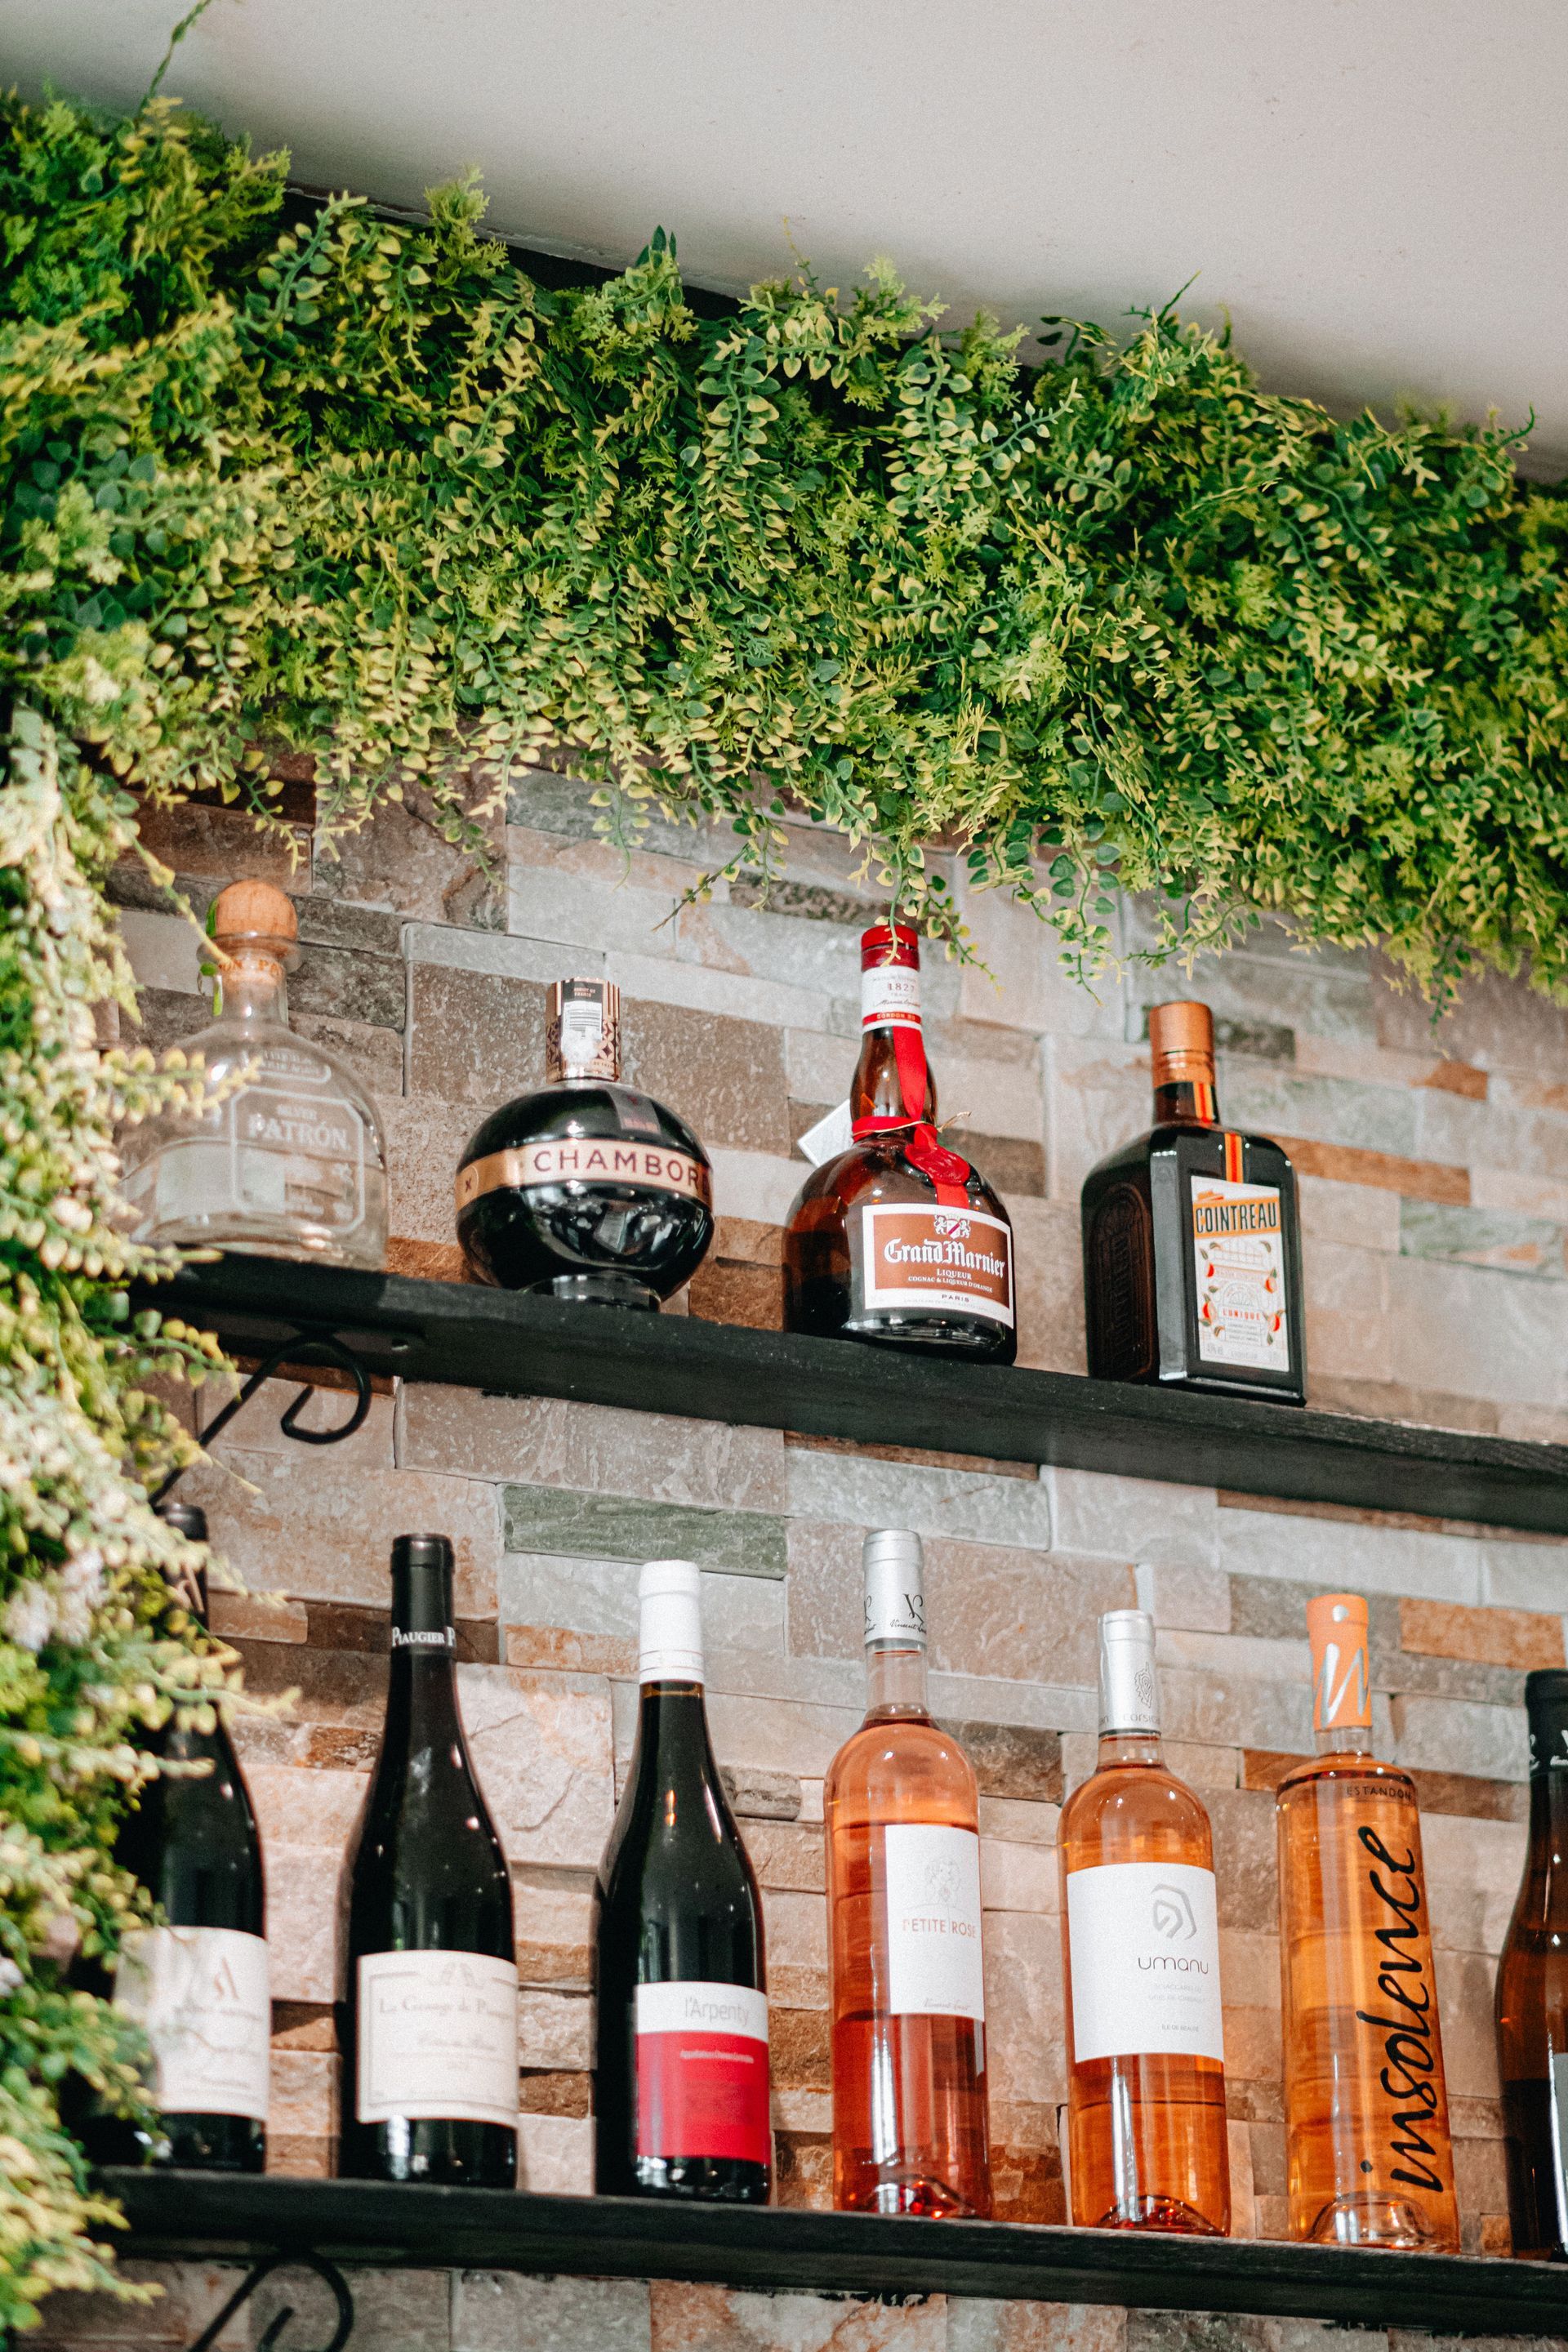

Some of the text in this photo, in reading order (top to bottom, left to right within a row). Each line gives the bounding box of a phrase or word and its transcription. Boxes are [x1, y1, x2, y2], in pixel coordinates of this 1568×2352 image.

[1196, 1202, 1276, 1233] COINTREAU
[937, 1268, 972, 1280] LIQUEUR
[942, 1279, 968, 1287] LIQUEUR
[942, 1294, 969, 1303] PARIS
[902, 1919, 946, 1933] PETITE
[1138, 1957, 1209, 1975] umanu
[1356, 1826, 1443, 2193] insolence
